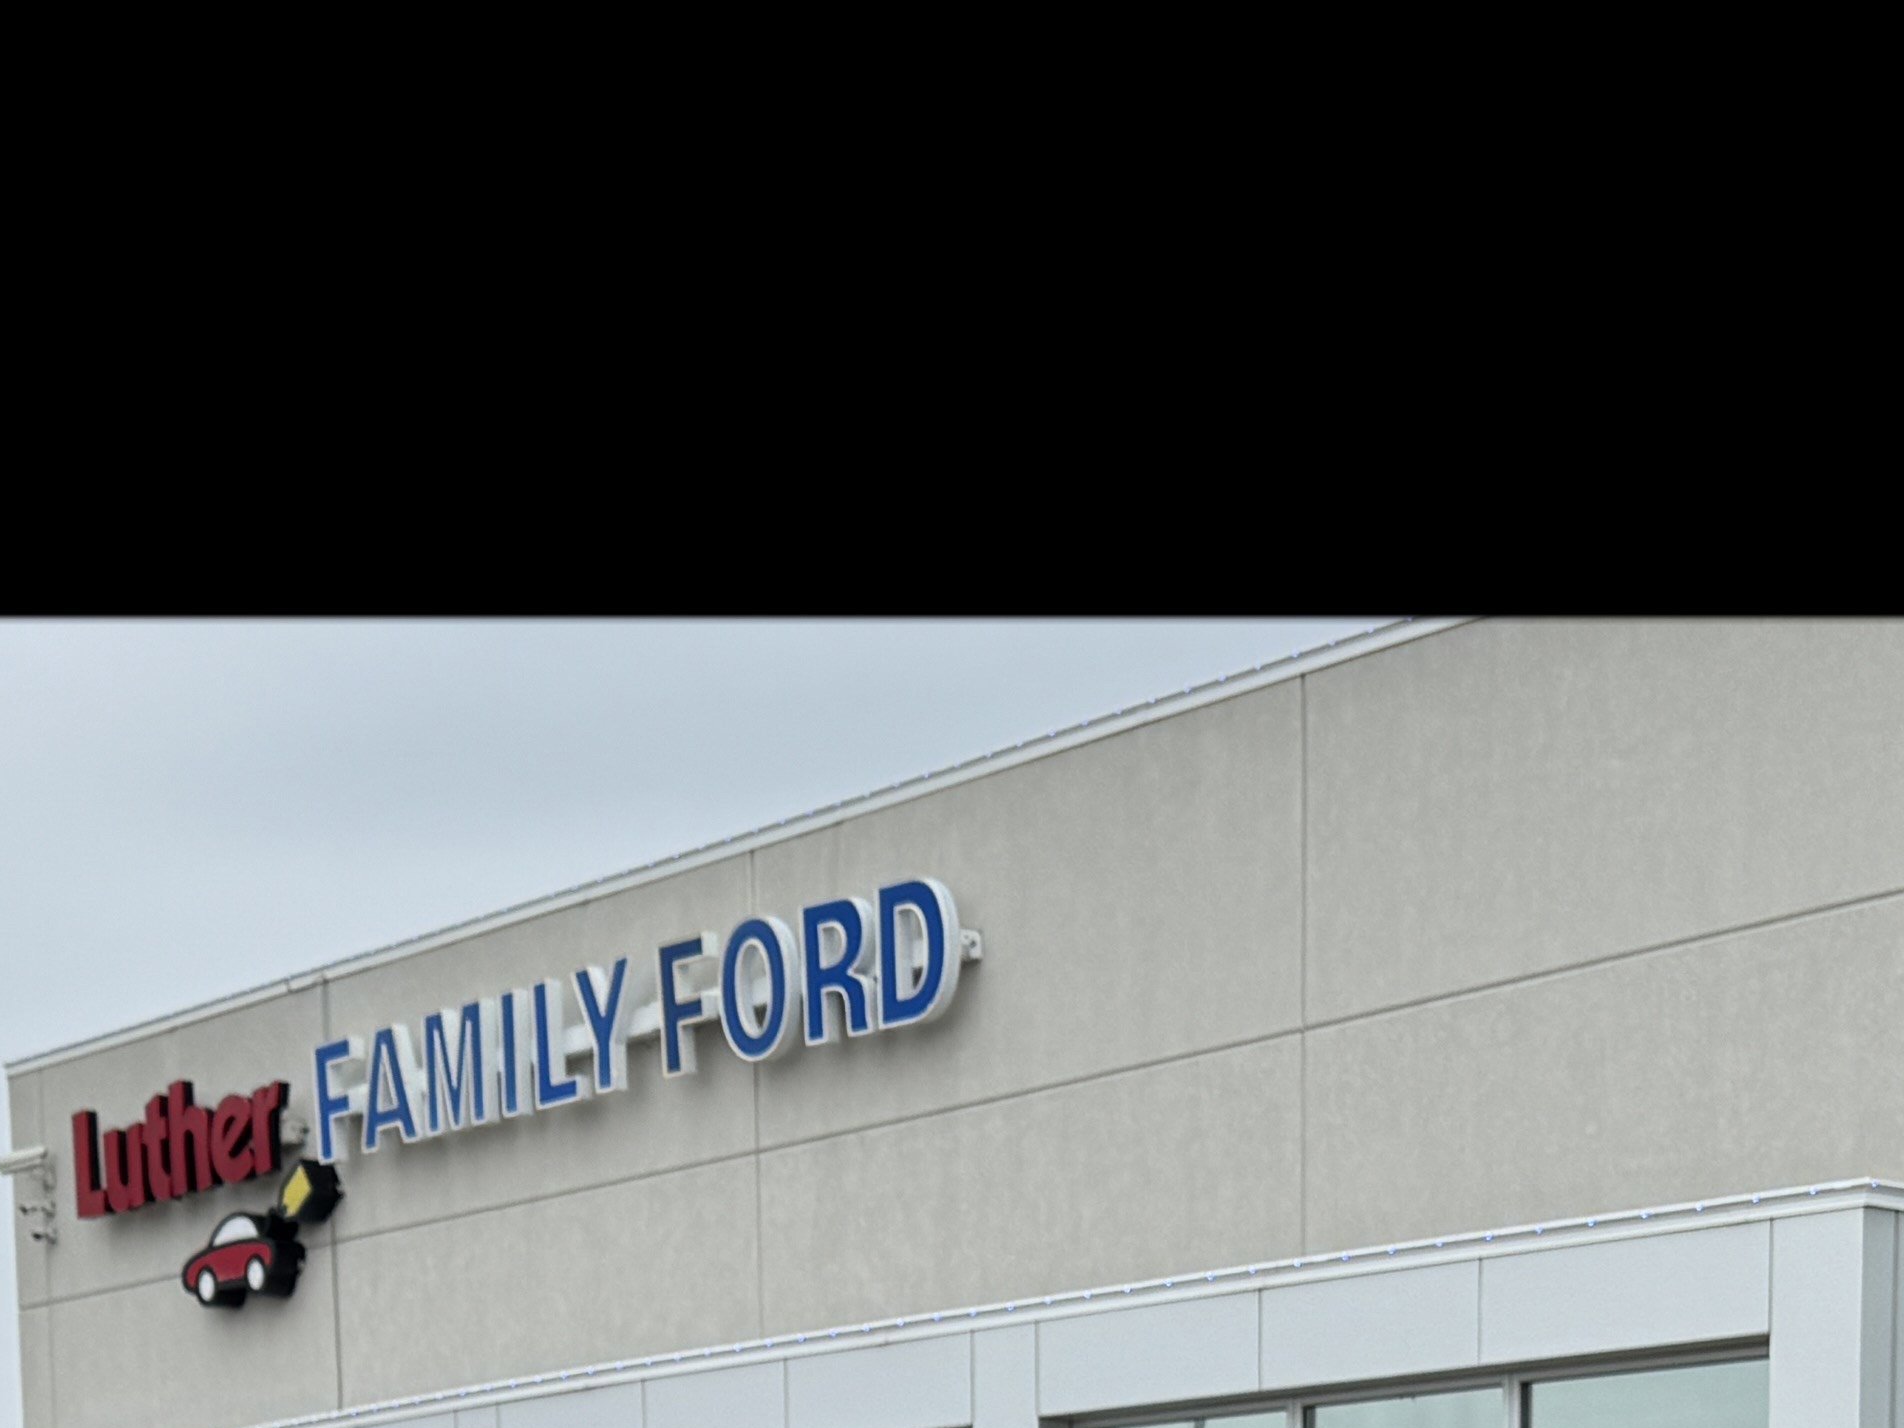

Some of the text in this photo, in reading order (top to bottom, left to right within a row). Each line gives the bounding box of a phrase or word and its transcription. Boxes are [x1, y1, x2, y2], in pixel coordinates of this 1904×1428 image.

[313, 876, 956, 1164] FAMILY FORD
[72, 1078, 290, 1220] Luther
